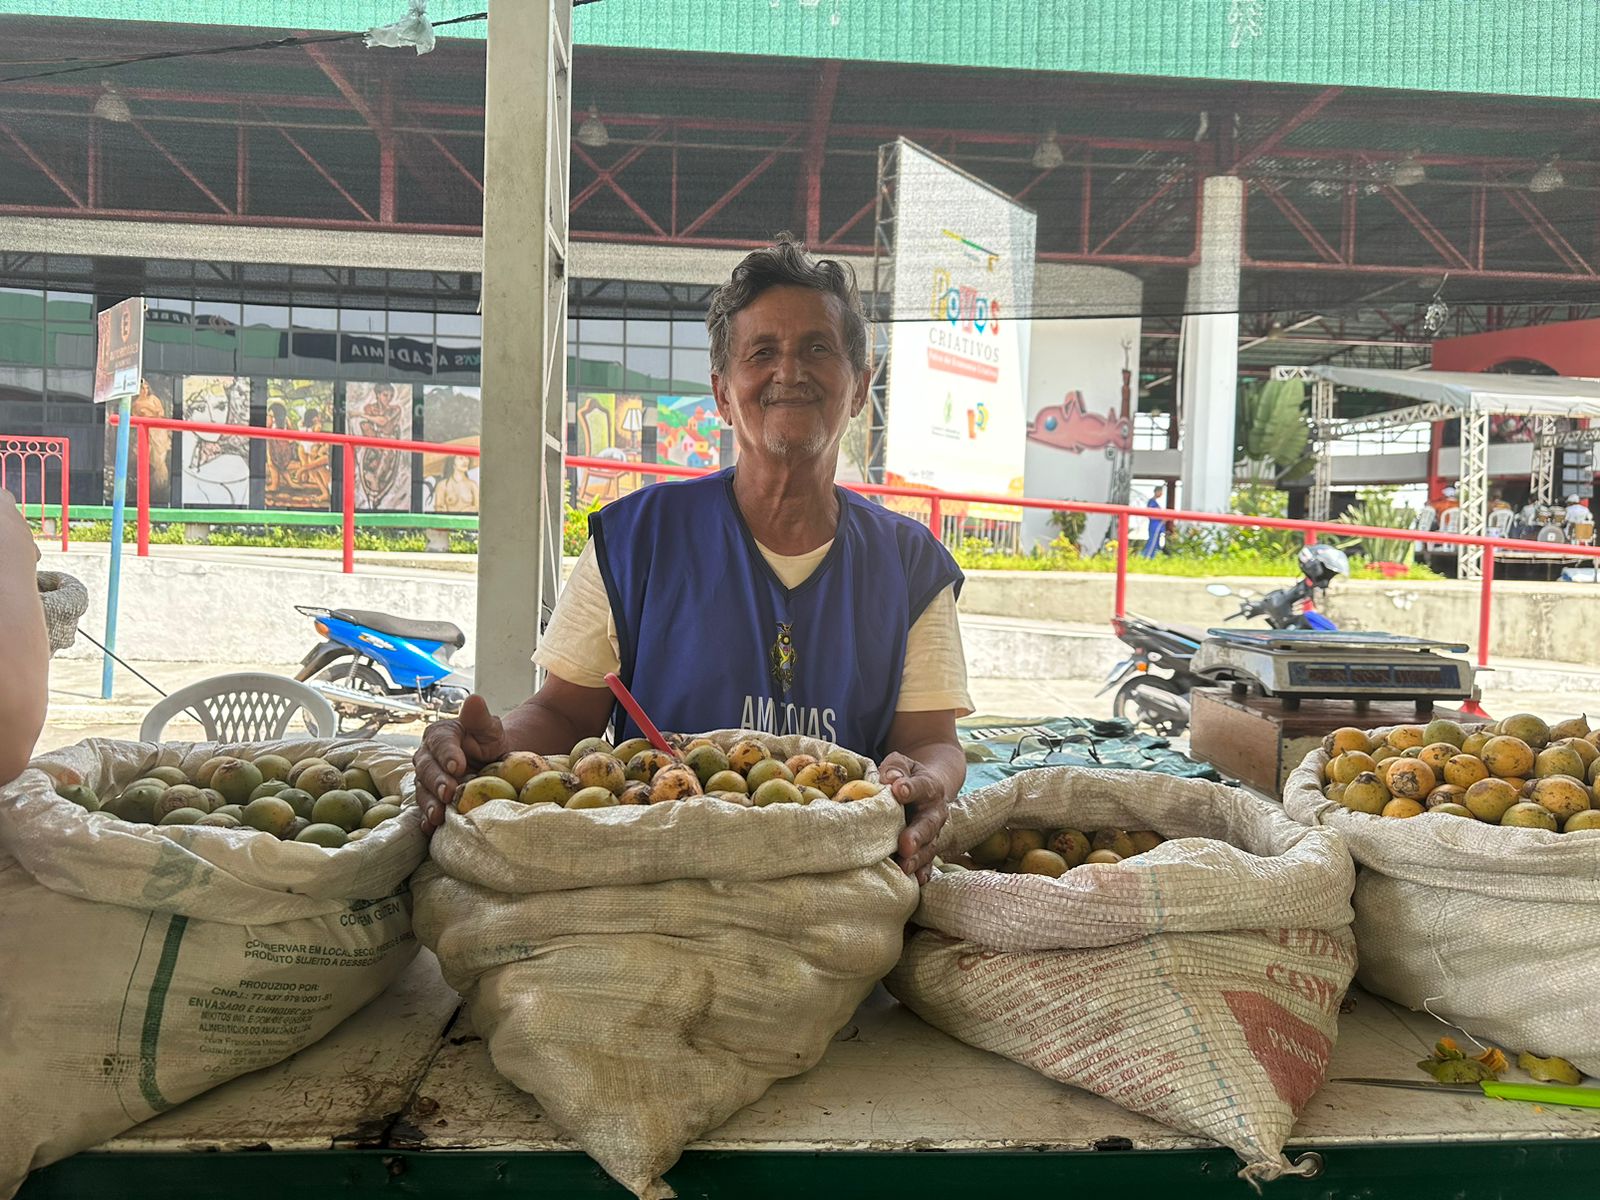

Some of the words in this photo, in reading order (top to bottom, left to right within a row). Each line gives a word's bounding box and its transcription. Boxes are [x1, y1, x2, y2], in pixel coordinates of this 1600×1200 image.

[928, 327, 1000, 363] CRIATIVOS
[245, 938, 307, 954] CONSERVAR
[308, 944, 321, 956] EM
[322, 945, 353, 958] LOCAL
[244, 950, 294, 965] PRODUTO
[295, 956, 331, 967] SUJEITO
[331, 957, 338, 967] A
[1027, 958, 1046, 970] 487
[1091, 958, 1129, 975] BRASIL
[239, 980, 297, 992] PRODUZIDO
[298, 983, 320, 992] POR:
[188, 996, 246, 1013] ENVASADO
[246, 1004, 255, 1013] E
